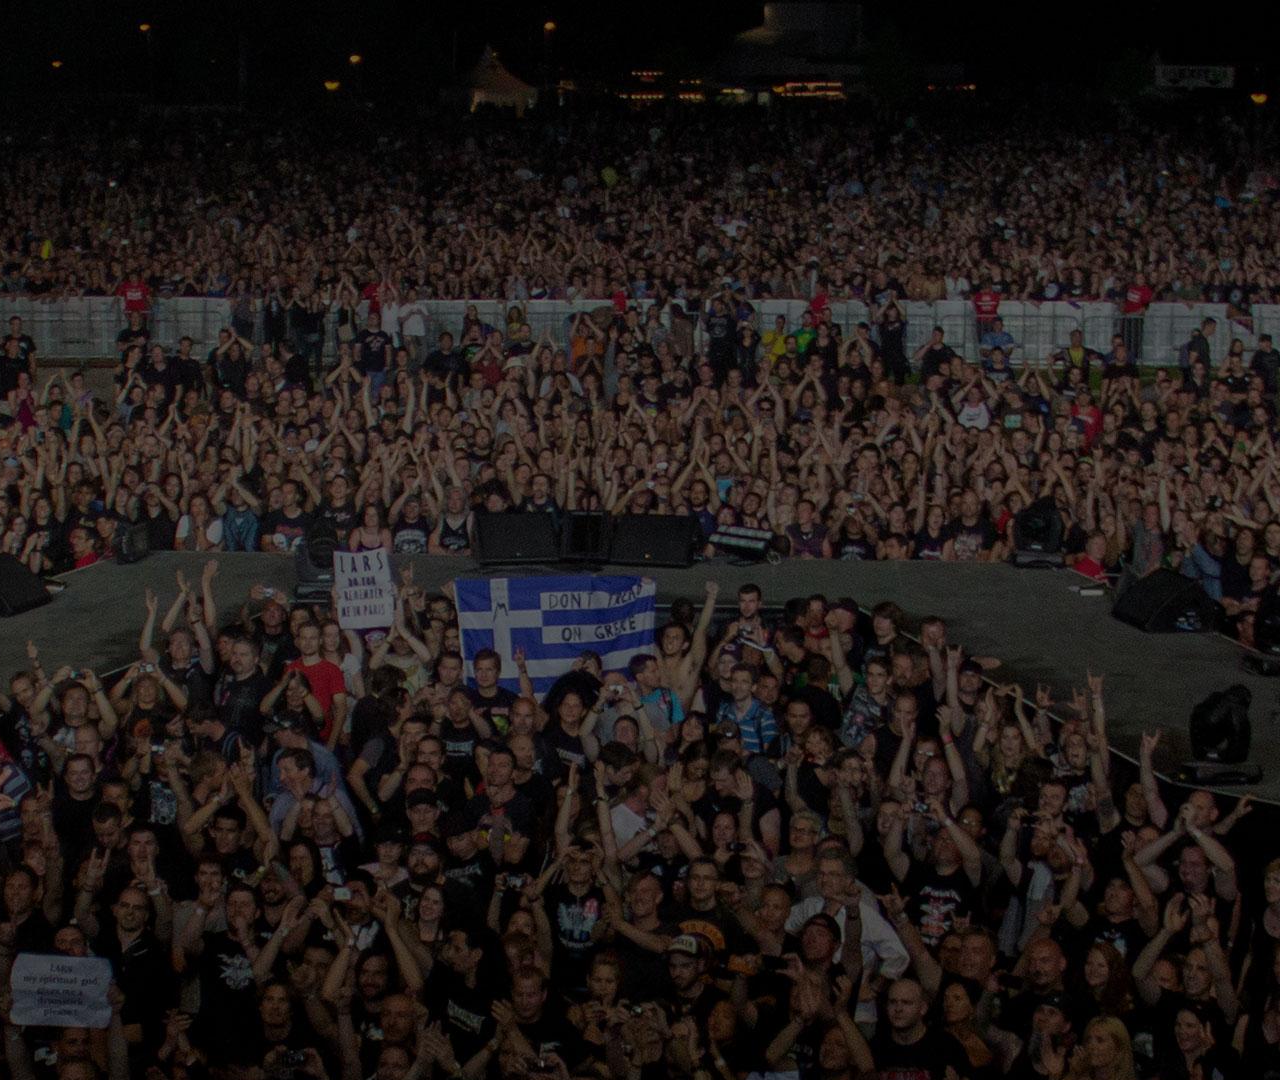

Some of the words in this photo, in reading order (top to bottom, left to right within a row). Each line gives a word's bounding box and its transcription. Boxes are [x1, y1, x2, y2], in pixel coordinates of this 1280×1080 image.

[339, 551, 383, 573] LARS
[363, 603, 385, 616] PARIS
[561, 626, 582, 642] ON
